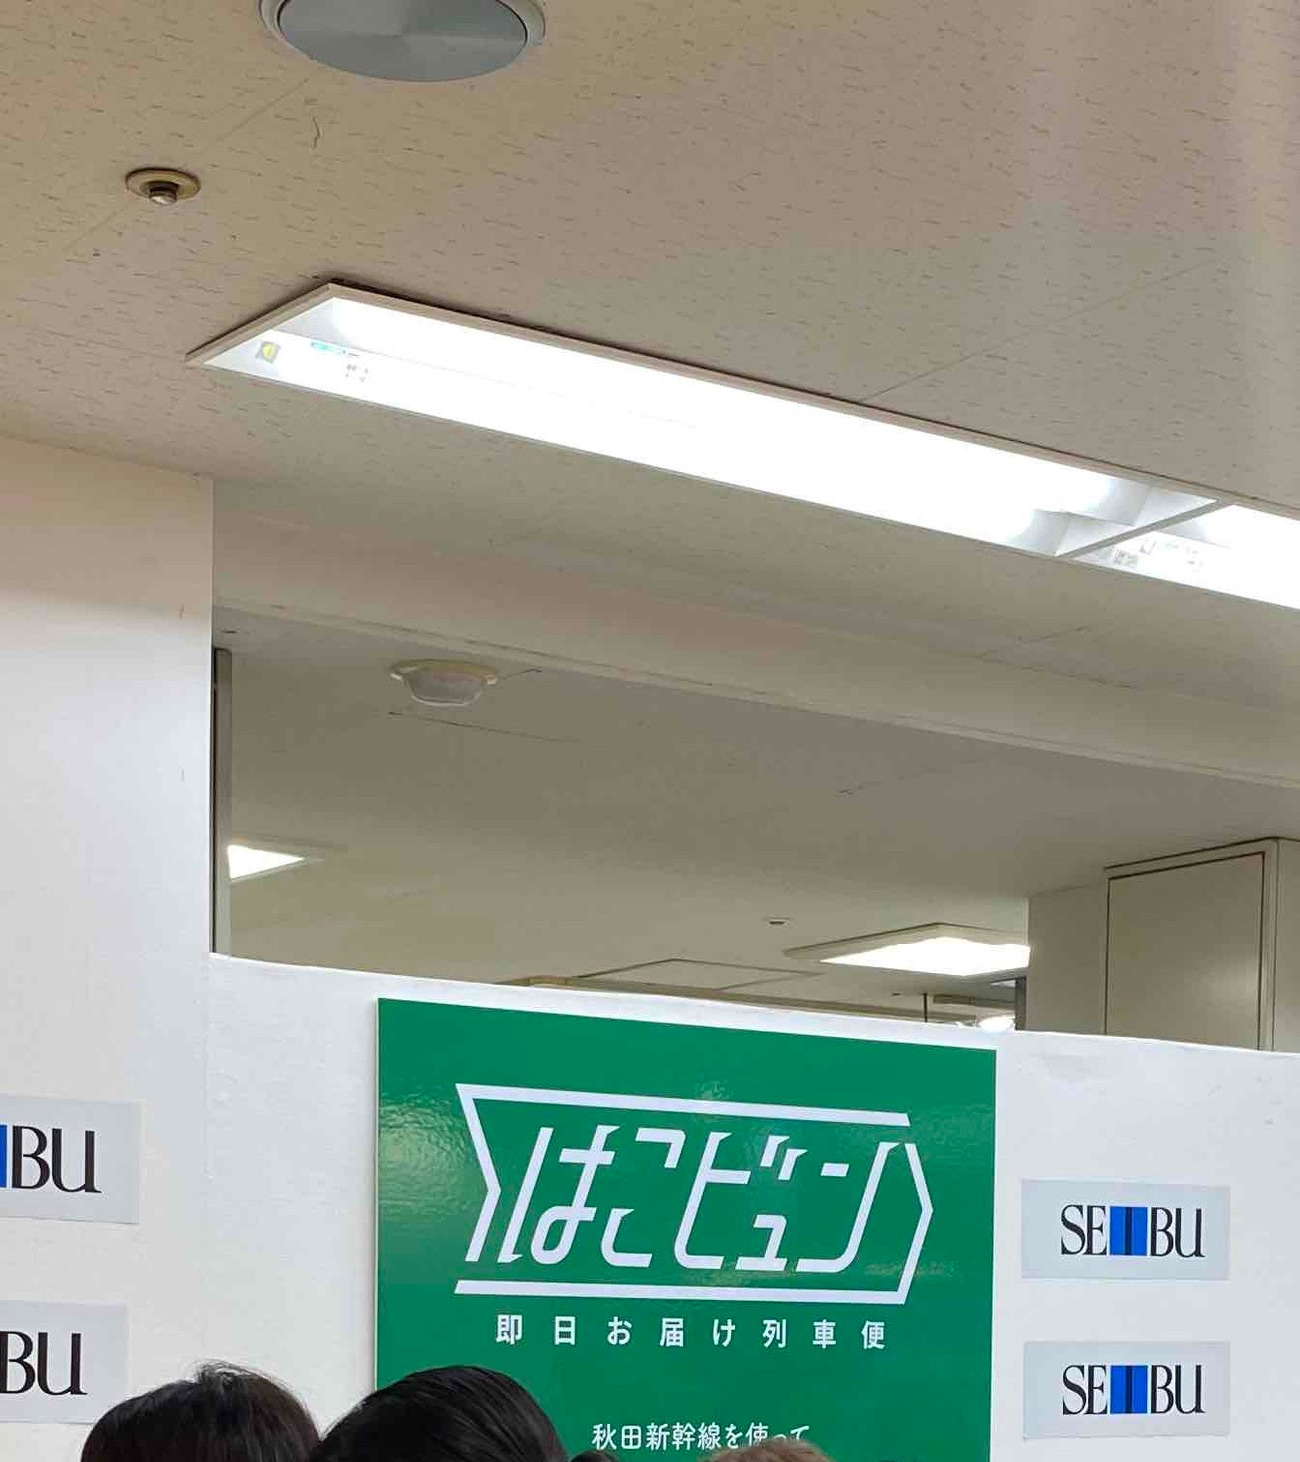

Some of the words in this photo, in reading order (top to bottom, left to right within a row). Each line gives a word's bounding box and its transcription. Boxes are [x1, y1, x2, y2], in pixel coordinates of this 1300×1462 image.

[497, 1124, 902, 1274] はこビュン
[1061, 1205, 1205, 1257] SEIBU
[495, 1314, 885, 1349] 即日お届け列車便
[1063, 1365, 1204, 1415] SEIBU
